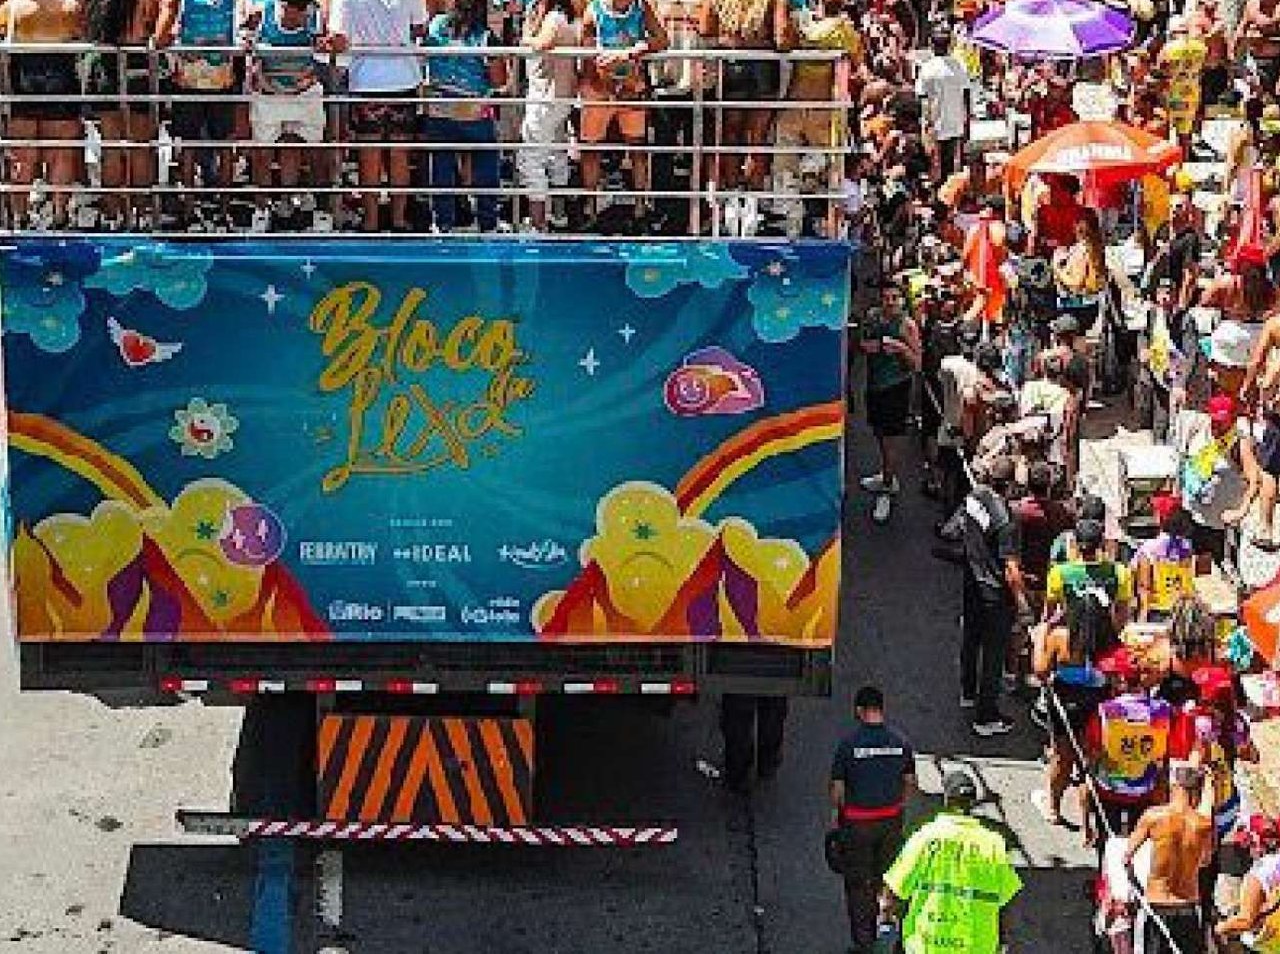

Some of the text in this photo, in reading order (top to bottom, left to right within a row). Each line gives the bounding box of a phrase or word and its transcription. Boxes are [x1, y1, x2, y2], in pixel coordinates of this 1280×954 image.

[310, 281, 518, 391] Bloco
[322, 368, 523, 491] Lexa
[412, 545, 472, 563] IDEAL
